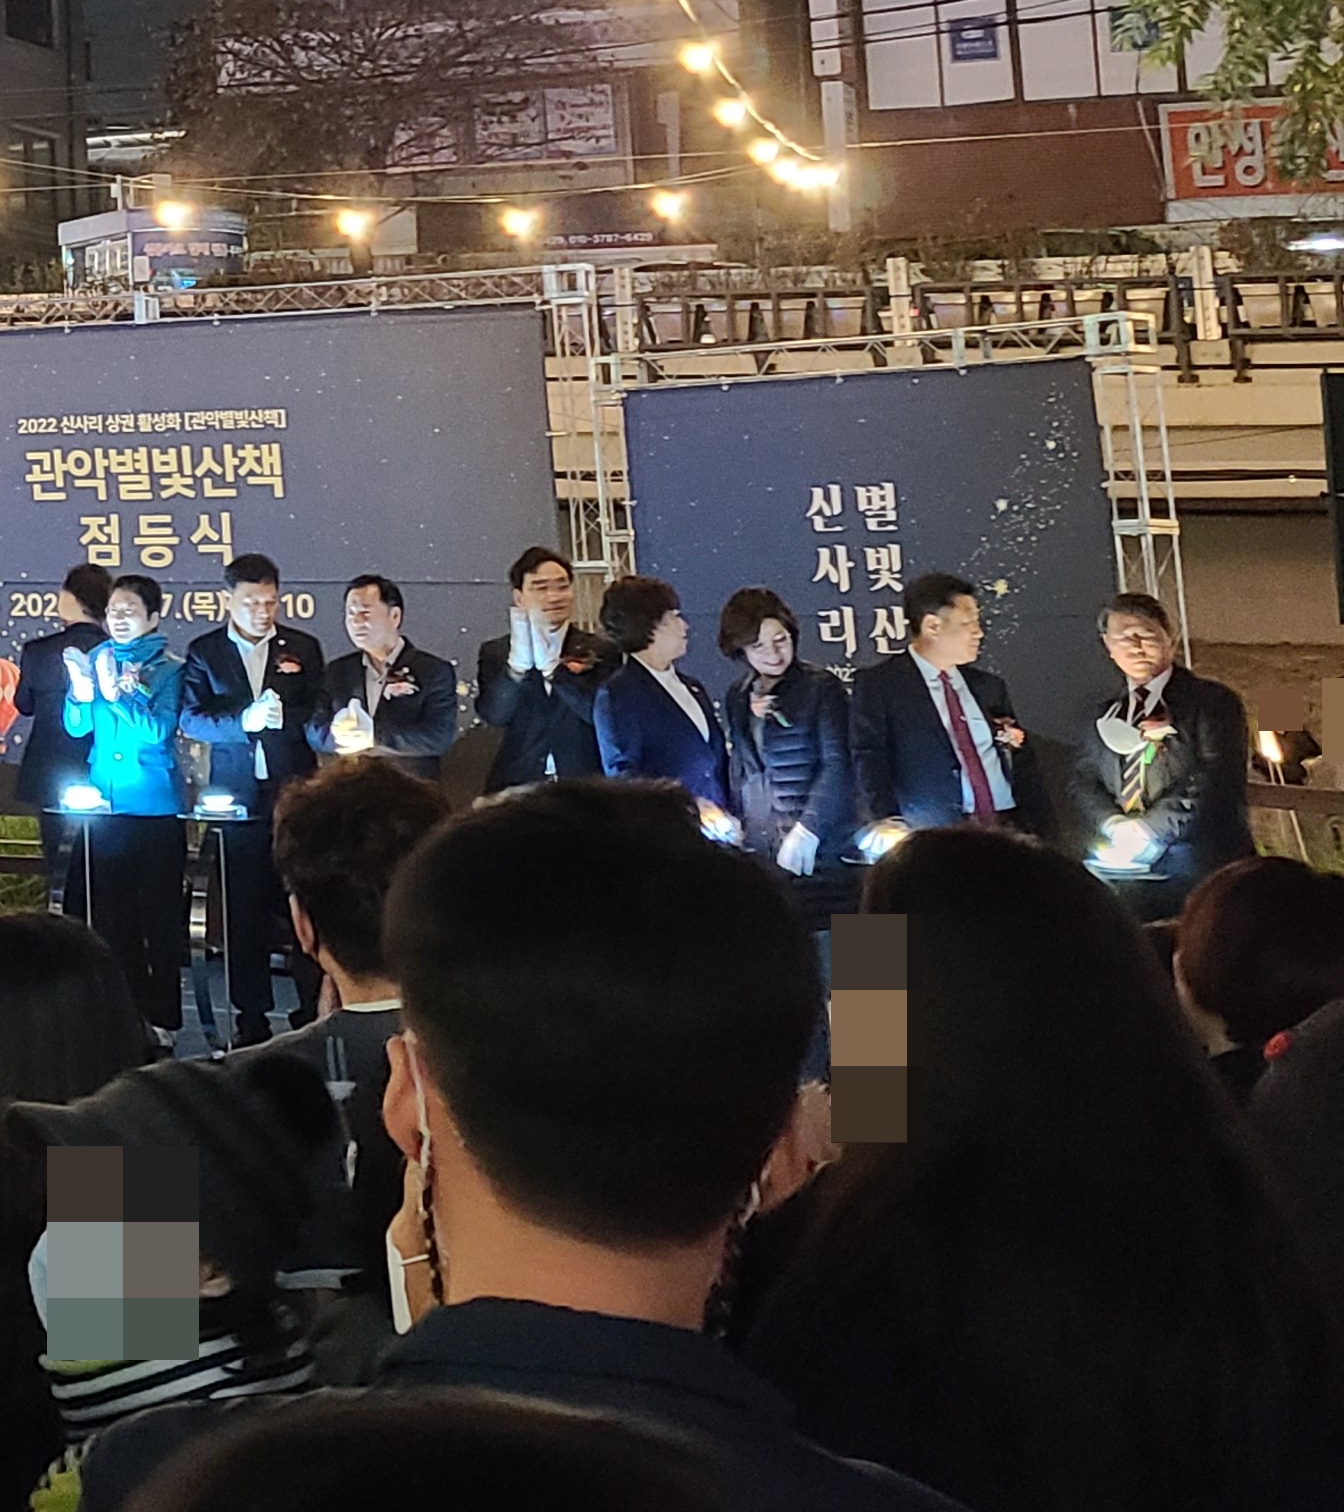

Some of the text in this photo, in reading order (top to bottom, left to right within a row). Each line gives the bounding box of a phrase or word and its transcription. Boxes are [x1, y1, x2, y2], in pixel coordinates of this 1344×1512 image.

[17, 408, 288, 434] 2022 신사리 상권 활성화 [관악별빛산책]
[24, 442, 285, 502] 관악별빛산책
